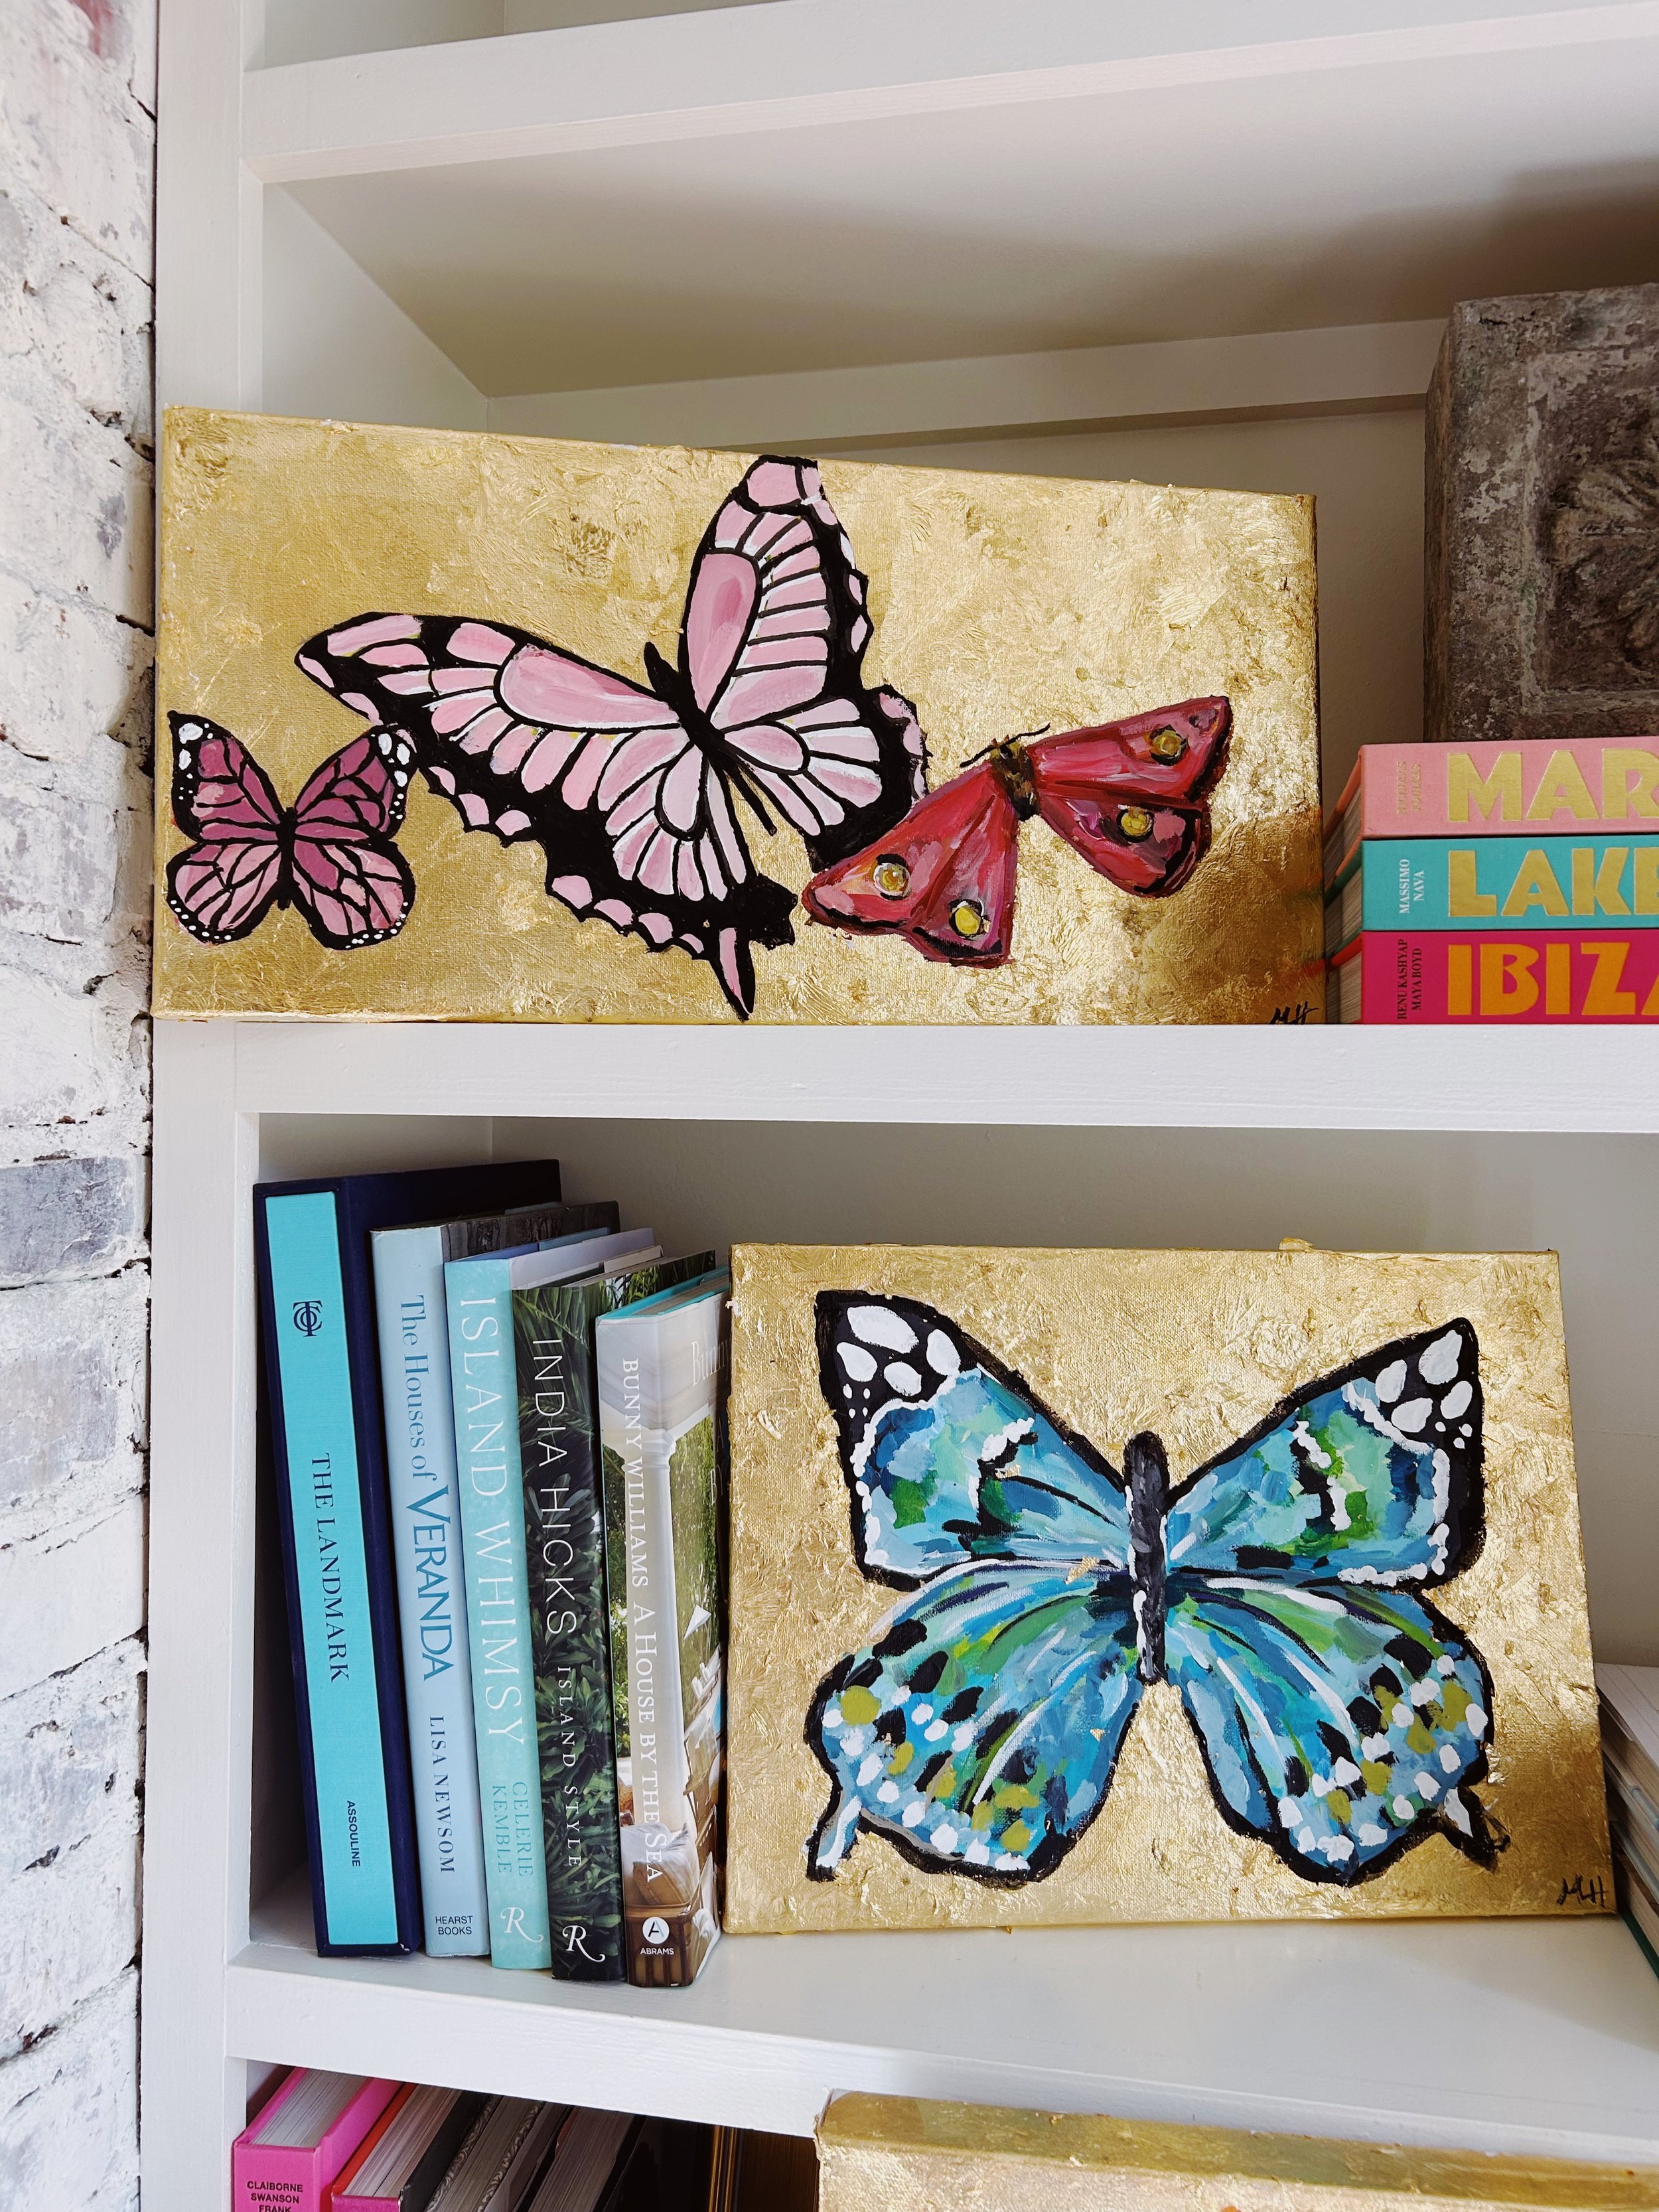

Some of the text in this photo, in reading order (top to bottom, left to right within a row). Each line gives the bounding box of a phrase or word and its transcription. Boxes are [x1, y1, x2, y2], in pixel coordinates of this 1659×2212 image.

[1398, 858, 1411, 914] MASSIMO
[1413, 869, 1425, 902] NAVA
[1396, 938, 1408, 1020] RENU KASHYAP
[1411, 947, 1422, 1011] MAYA BOYD
[1448, 942, 1659, 1015] IBIZ
[400, 1295, 455, 1682] The Houses of VERANDA
[460, 1297, 525, 1745] ISLAND WHIMSY
[532, 1339, 577, 1635] INDIA HICKS
[311, 1452, 350, 1683] THE LANDMARK
[622, 1358, 668, 1883] BUNNY WILLIAMS A HOUSE BY THE SEA
[430, 1716, 455, 1874] LISA NEWSOM
[557, 1666, 582, 1868] ISLAND STYLE
[346, 1800, 362, 1868] ASSOULINE
[492, 1785, 512, 1874] KEMBLE
[512, 1781, 534, 1877] CELERIE
[435, 1915, 473, 1926] HEARST
[437, 1926, 472, 1936] BOOKS
[500, 1907, 544, 1943] R
[562, 1925, 606, 1962] R
[247, 2180, 303, 2193] CLAIBORNE
[250, 2192, 299, 2204] SWANSON
